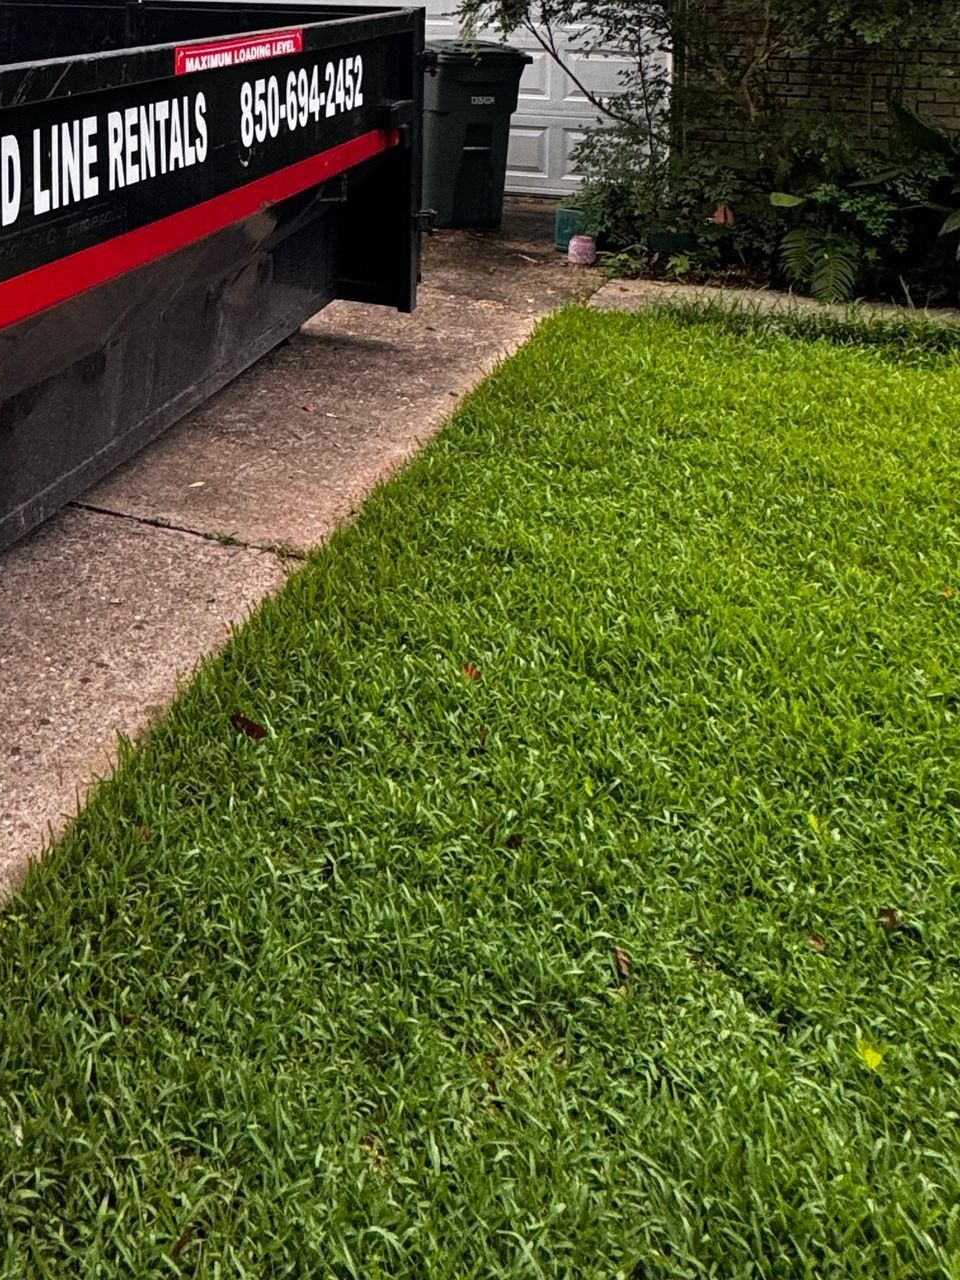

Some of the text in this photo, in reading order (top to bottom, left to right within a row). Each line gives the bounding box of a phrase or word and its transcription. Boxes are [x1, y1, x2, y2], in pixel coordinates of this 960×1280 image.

[185, 39, 296, 73] MAXIMUM LOADING LEVEL
[33, 115, 99, 216] LINE
[108, 91, 208, 191] RENTALS
[240, 55, 364, 148] 850-694-2452
